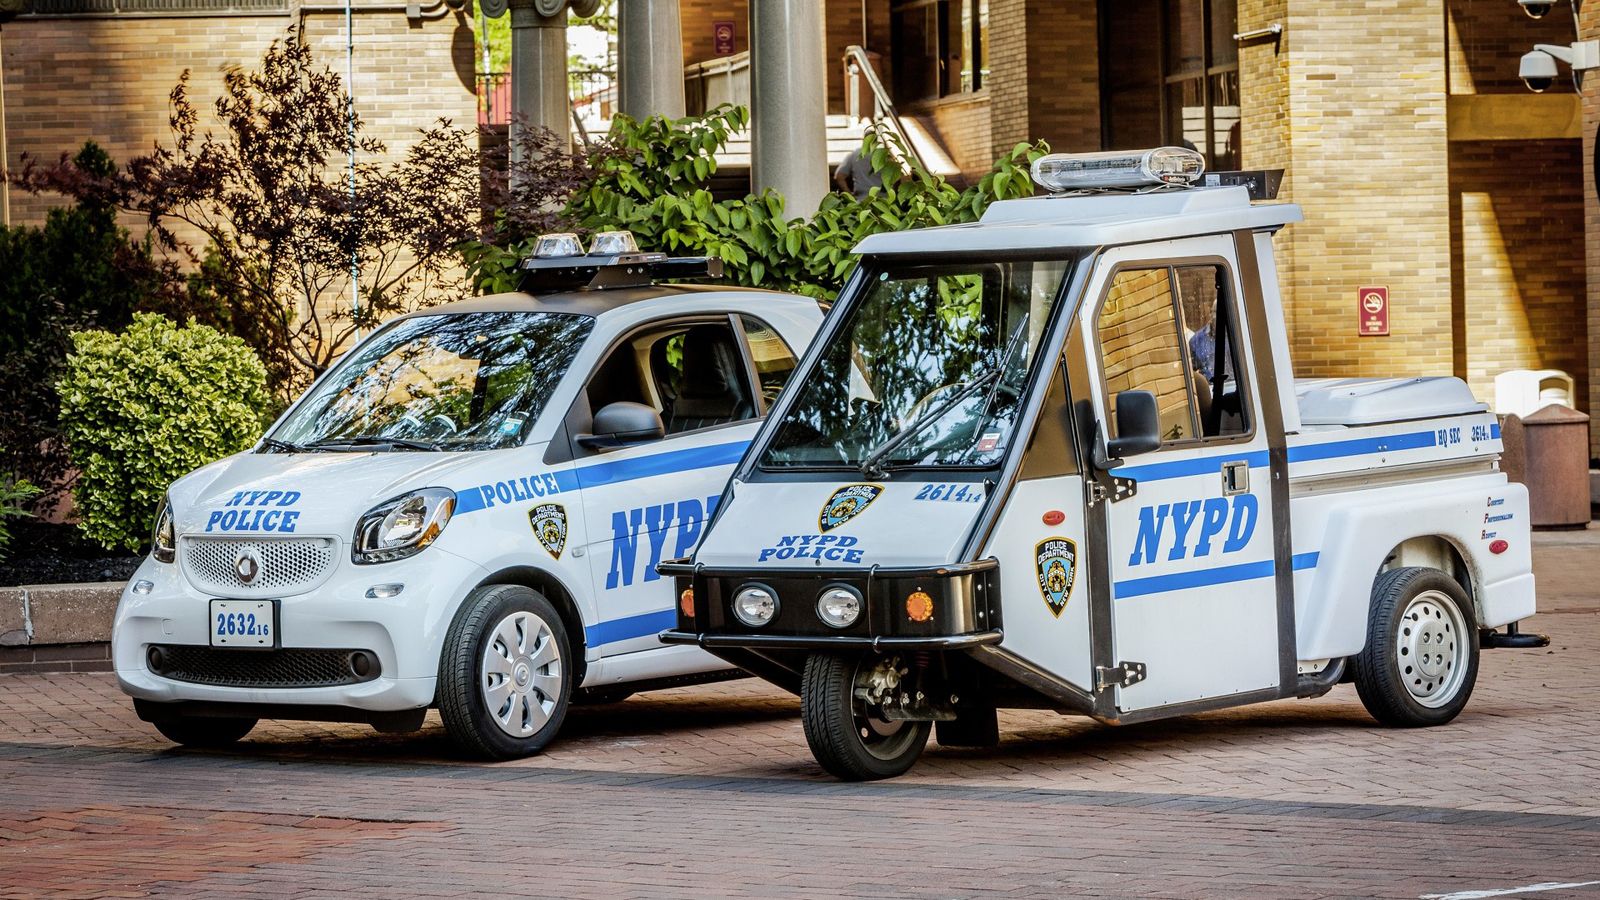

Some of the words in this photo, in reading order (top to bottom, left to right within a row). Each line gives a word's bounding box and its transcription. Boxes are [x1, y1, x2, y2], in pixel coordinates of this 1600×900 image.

[1438, 428, 1447, 448] HQ
[1449, 427, 1461, 444] SEC
[225, 491, 301, 507] NYPD
[480, 473, 559, 508] POLICE
[531, 511, 565, 525] DEPARTMENT
[536, 505, 557, 515] POLICE
[205, 509, 300, 533] POLICE
[1128, 494, 1258, 567] NYPD
[606, 495, 721, 590] NYP
[776, 534, 858, 548] NYPD
[1044, 541, 1068, 552] POLICE
[758, 546, 865, 564] POLICE
[1038, 548, 1075, 565] DEPARTMENT
[1039, 573, 1048, 592] CITY
